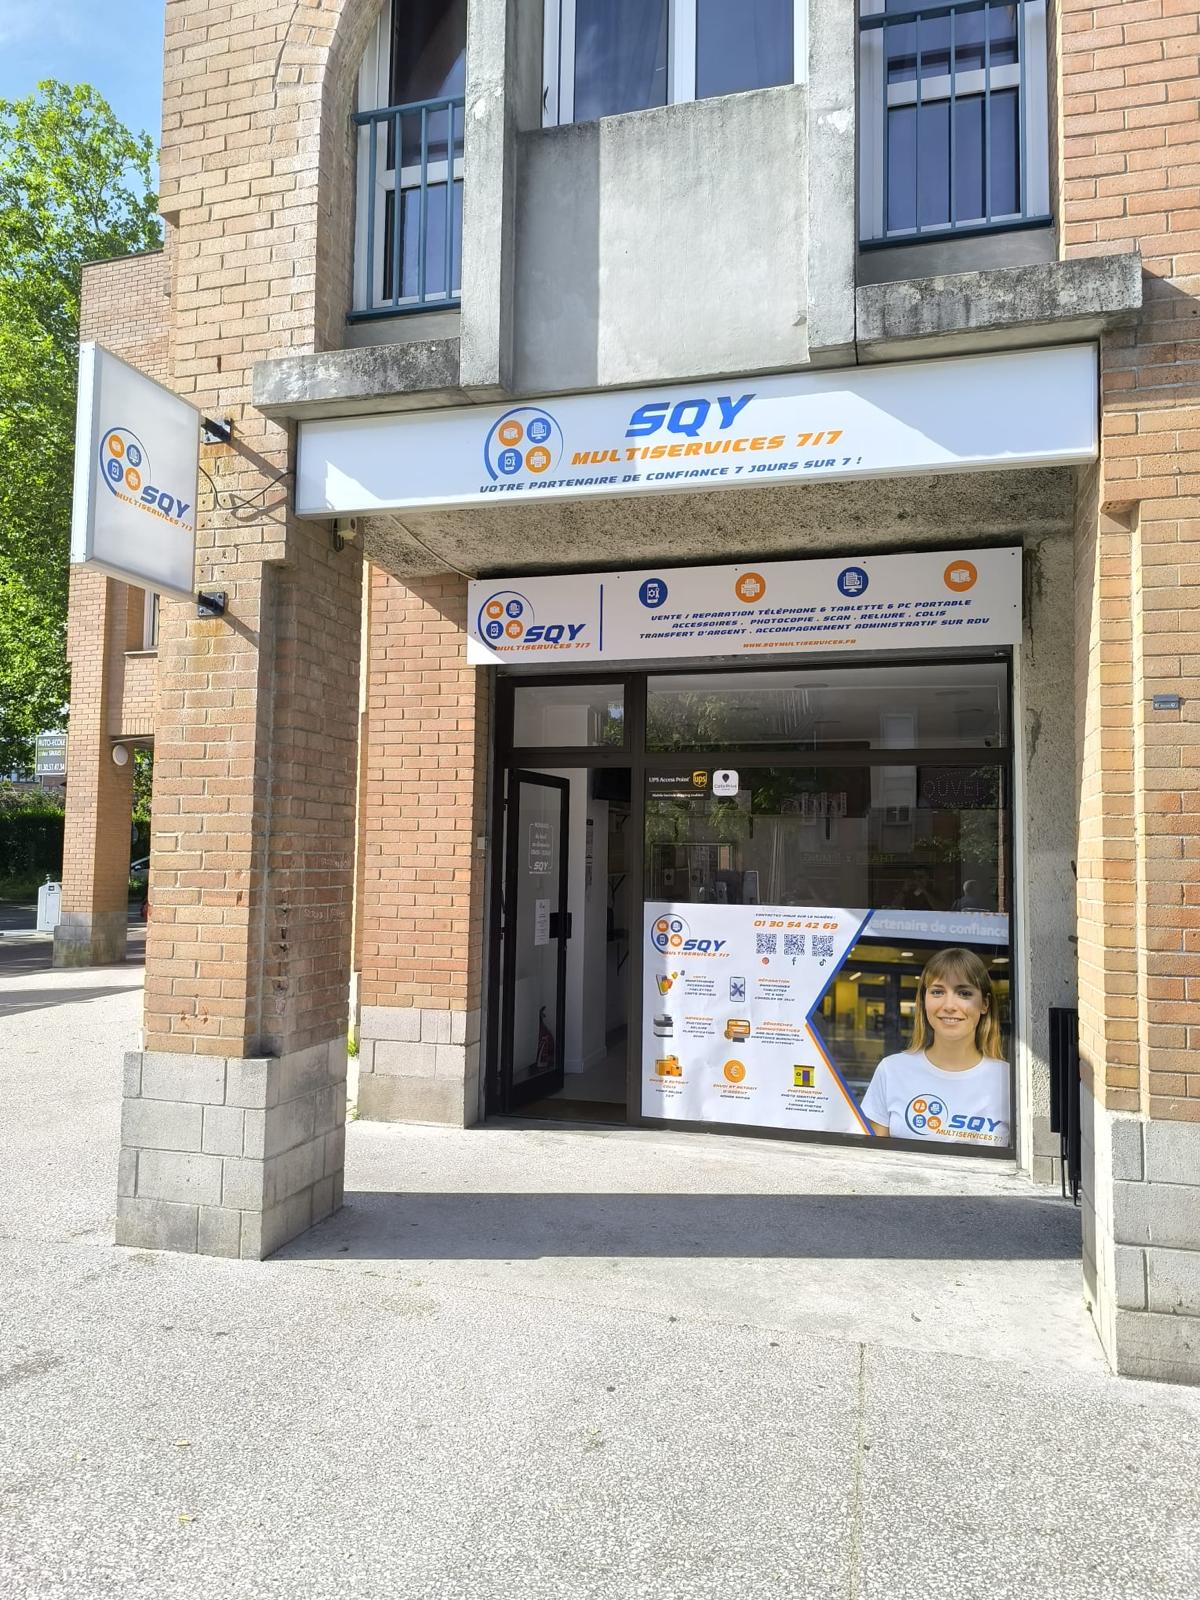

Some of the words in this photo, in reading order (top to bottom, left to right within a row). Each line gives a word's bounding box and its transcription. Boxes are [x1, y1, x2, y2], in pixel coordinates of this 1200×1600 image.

[625, 393, 757, 437] SQY
[571, 434, 786, 465] MULTISERVICES
[796, 430, 843, 448] 7/7
[480, 482, 525, 493] VOTRE
[529, 475, 617, 490] PARTENAIRE
[622, 474, 641, 483] DE
[646, 467, 730, 481] CONFIANCE
[734, 466, 744, 475] 7
[748, 461, 799, 473] JOURS
[803, 458, 837, 469] SUR
[842, 457, 852, 466] 7
[856, 456, 863, 465] !
[116, 491, 179, 526] MULTISERVICES
[141, 485, 190, 518] SQY
[651, 613, 686, 621] VENTE
[692, 609, 755, 619] REPARATION
[758, 607, 817, 616] TÉLÉPHONE
[830, 603, 884, 612] TABLETTE
[914, 599, 972, 608] PORTABLE
[672, 619, 739, 629] ACCESSOIRES
[750, 616, 815, 625] PHOTOCOPIE
[823, 614, 852, 622] SCAN
[859, 612, 905, 620] RELIURE
[914, 610, 948, 618] COLIS
[523, 624, 587, 644] SQY
[640, 630, 695, 640] TRANSFERT
[697, 628, 747, 637] D'ARGENT
[755, 624, 852, 634] ACCOMPAGNEMENT
[854, 620, 938, 630] ADMINISTRATIF
[940, 619, 964, 627] SUR
[966, 617, 990, 625] RDV
[495, 643, 572, 651] MULTISERVICES
[743, 638, 857, 649] WWW.SQYMULTISERVICES.FR
[694, 775, 707, 786] ups
[823, 922, 839, 930] 69
[931, 920, 945, 933] de
[683, 939, 726, 952] SQY
[948, 1114, 1002, 1132] SQY
[936, 1129, 993, 1141] MULTISERVICES
